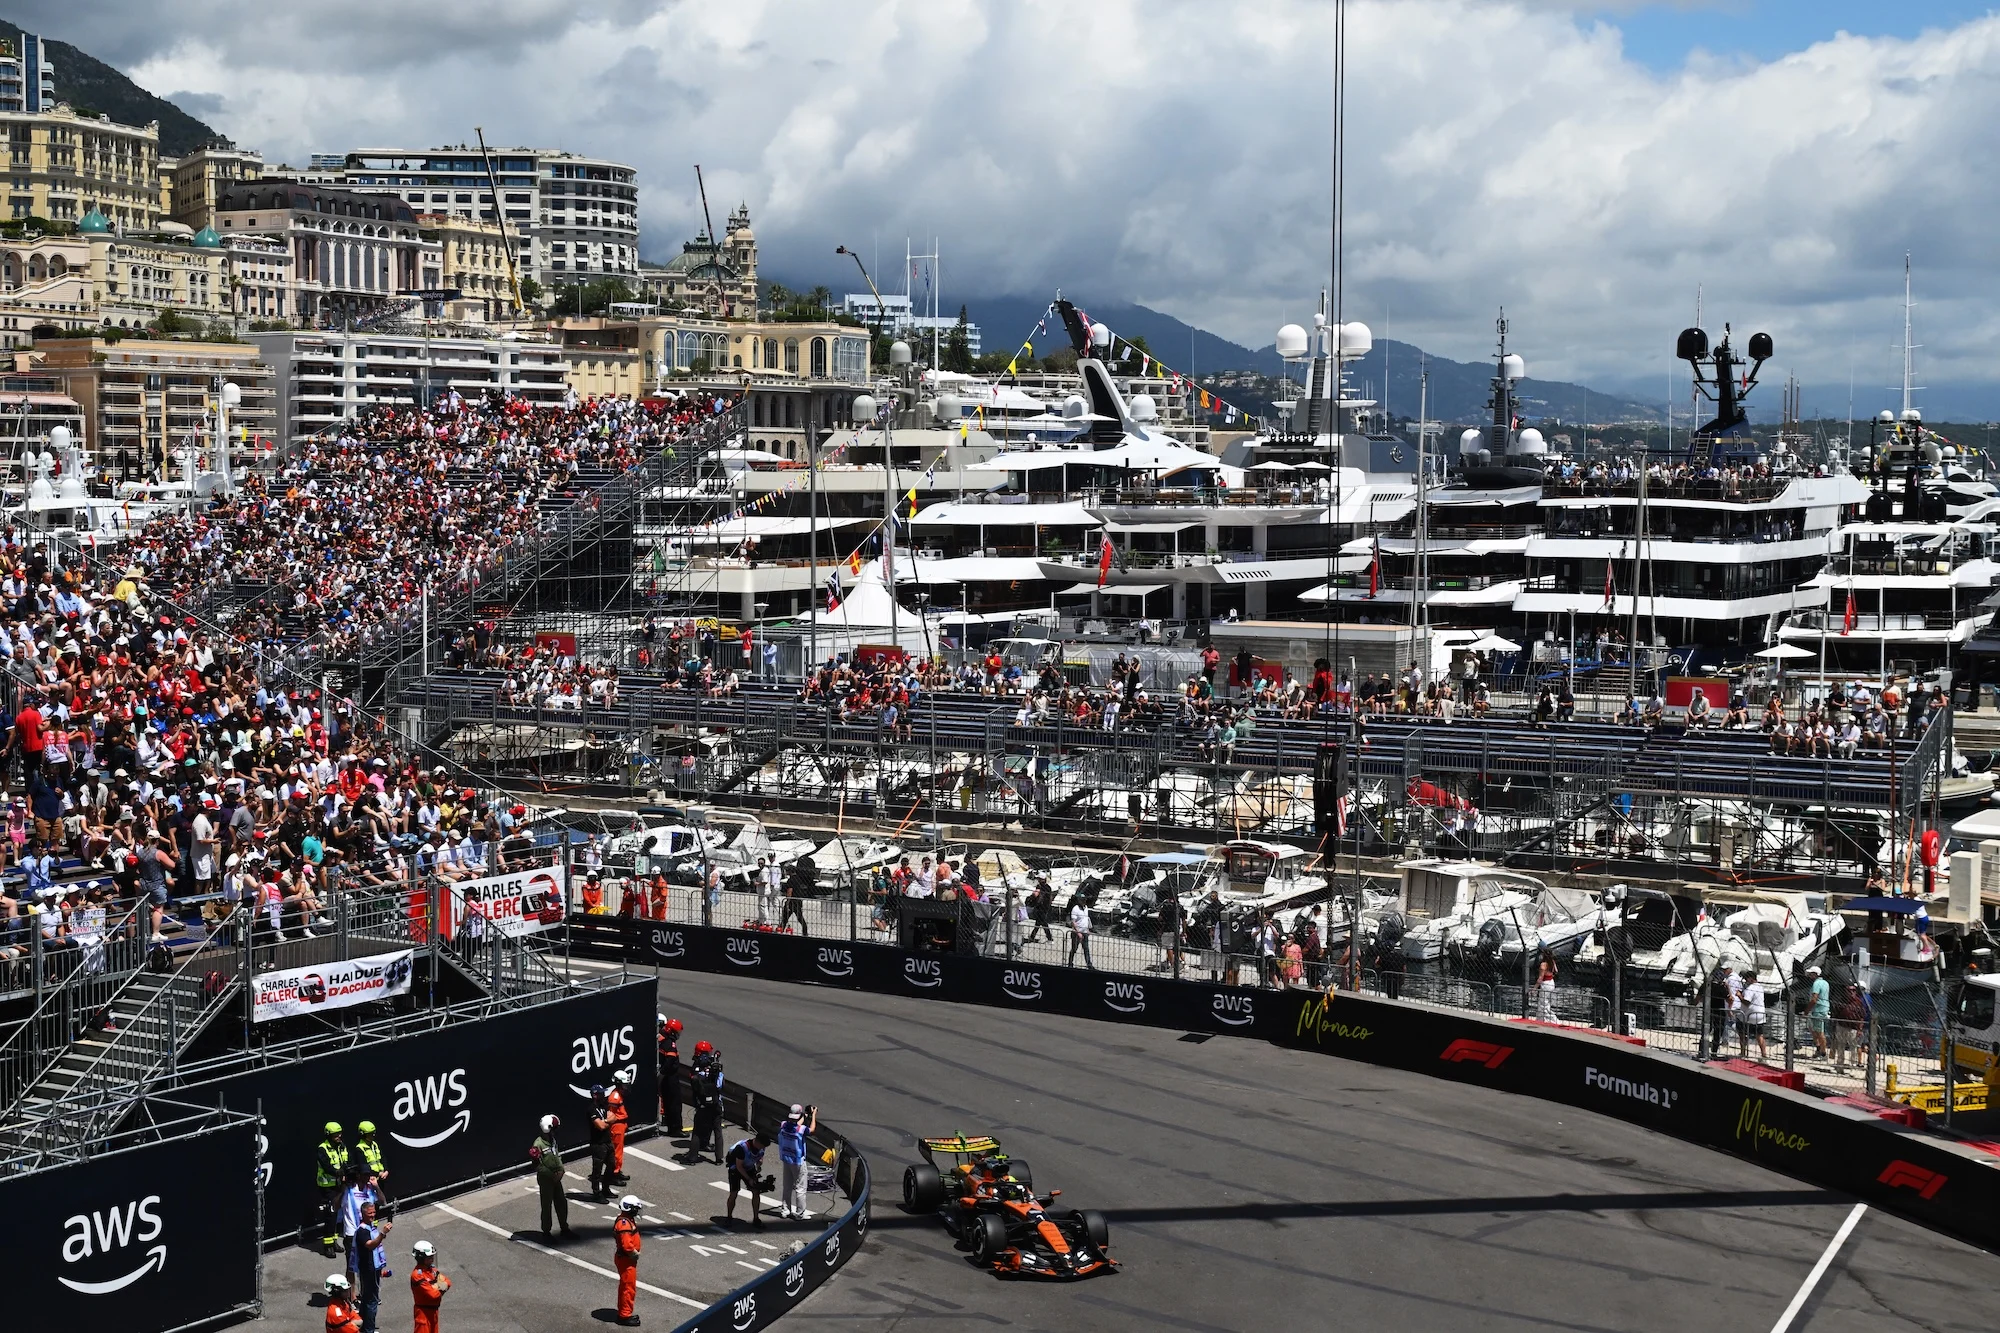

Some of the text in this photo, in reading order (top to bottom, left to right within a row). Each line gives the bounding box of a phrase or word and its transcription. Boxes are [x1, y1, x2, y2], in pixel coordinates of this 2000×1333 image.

[463, 880, 522, 904] HARLES
[455, 897, 521, 926] LLERC
[508, 922, 525, 931] CLUB
[651, 929, 684, 947] aws
[726, 937, 760, 955] aws
[818, 947, 852, 965] aws
[904, 957, 941, 976] aws
[355, 967, 382, 979] DUE
[1003, 969, 1042, 989] aws
[261, 978, 299, 991] CHARLES
[328, 979, 384, 996] D'ACCIAIO
[1105, 981, 1144, 1001] aws
[255, 987, 298, 1005] LECLERC
[1212, 993, 1253, 1014] aws
[1297, 1000, 1374, 1044] Monaco
[571, 1025, 635, 1074] aws
[1439, 1038, 1516, 1069] F1
[393, 1068, 467, 1121] aws
[1585, 1066, 1659, 1105] Formula
[1736, 1098, 1811, 1151] Monaco
[1876, 1159, 1949, 1200] F1
[857, 1202, 868, 1225] aws
[62, 1195, 163, 1263] aws
[825, 1231, 840, 1251] aws
[785, 1260, 804, 1287] aws
[733, 1292, 755, 1320] aws
